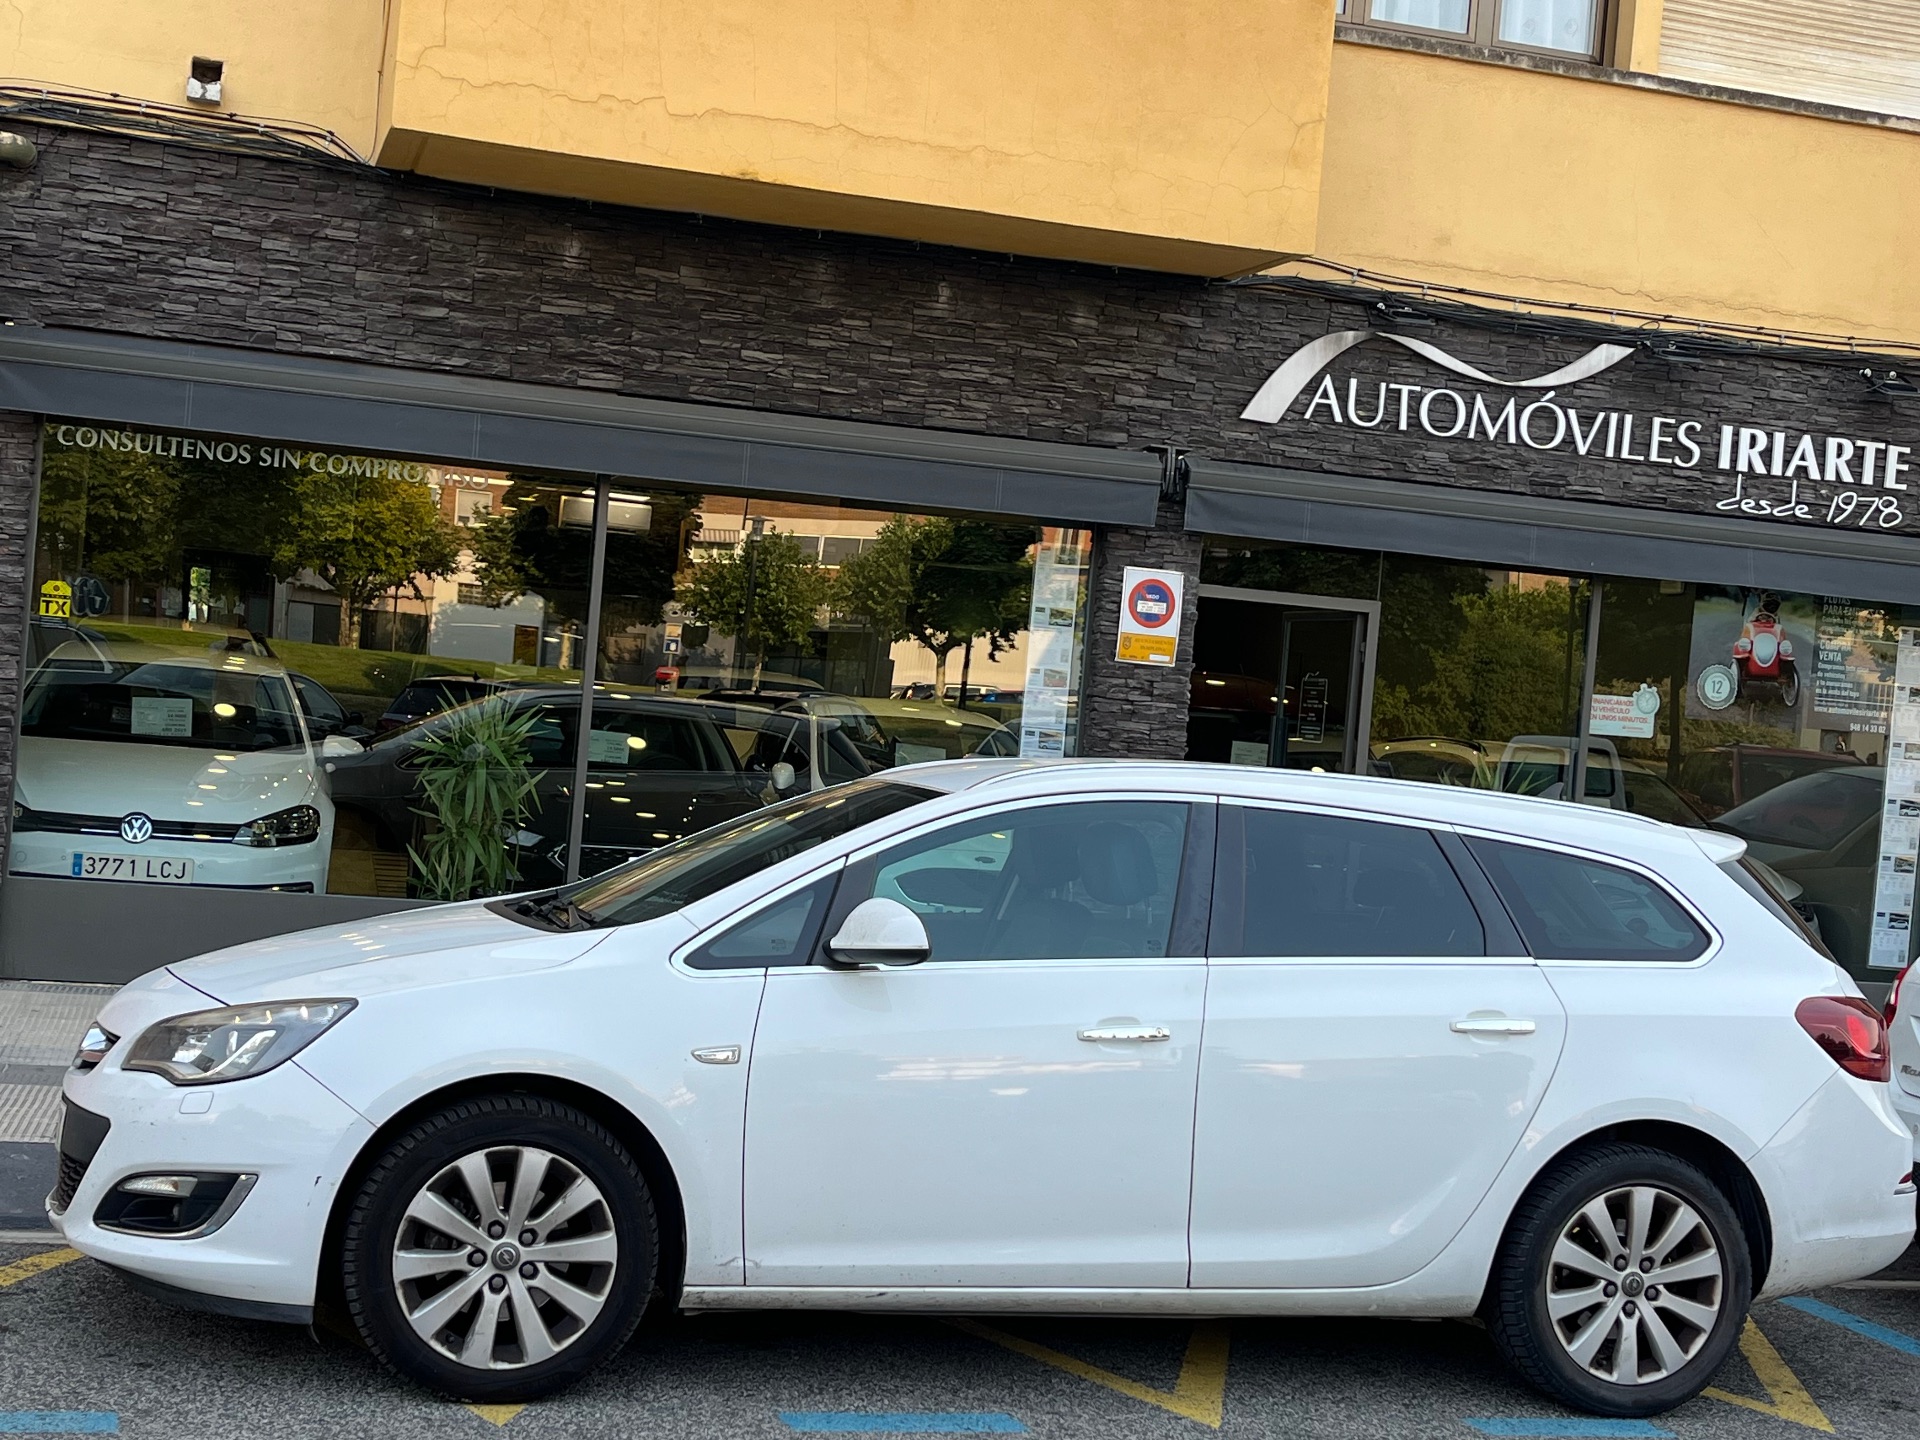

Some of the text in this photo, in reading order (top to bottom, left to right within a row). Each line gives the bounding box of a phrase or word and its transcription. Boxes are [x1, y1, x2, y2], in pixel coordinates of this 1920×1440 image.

[1303, 373, 1911, 491] AUTOMÓVILES IRIARTE
[57, 425, 251, 464] CONSULTENOS
[259, 446, 301, 470] SIN
[1716, 473, 1903, 528] desde 1978
[41, 600, 68, 616] TX
[1822, 604, 1842, 614] PARA
[1818, 651, 1842, 662] VENTA
[1711, 680, 1723, 694] 12
[1592, 698, 1634, 707] INANCIAMOS
[1862, 723, 1869, 732] 14
[84, 857, 186, 879] 3771 LCJ
